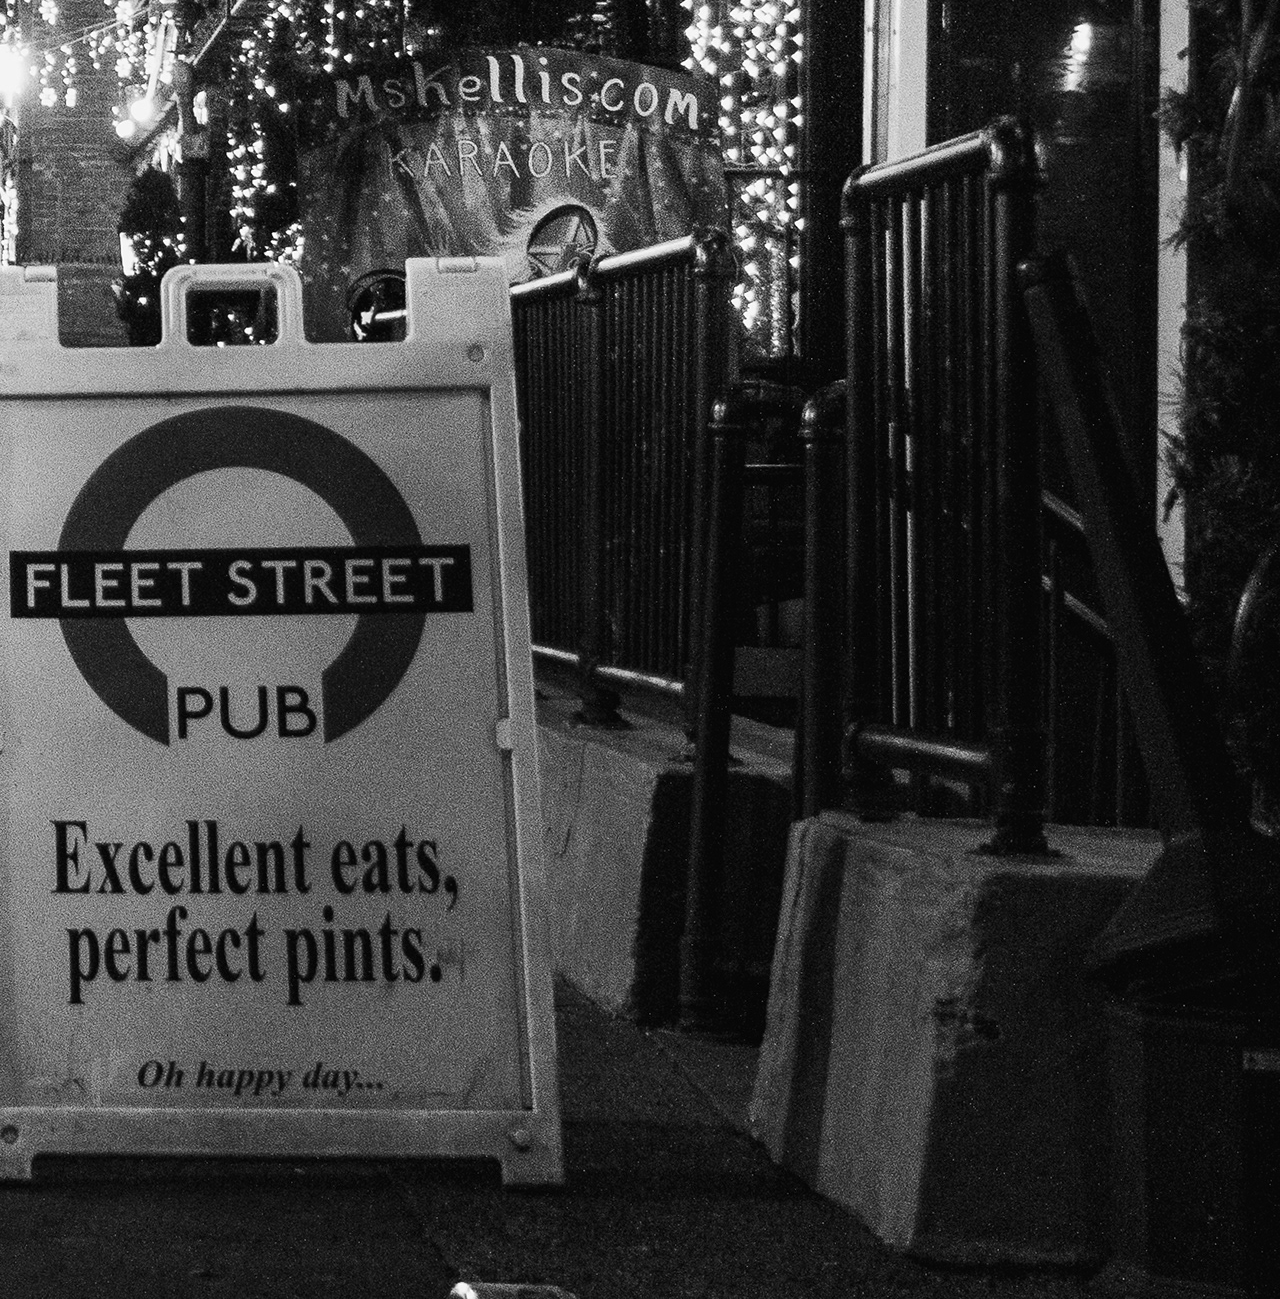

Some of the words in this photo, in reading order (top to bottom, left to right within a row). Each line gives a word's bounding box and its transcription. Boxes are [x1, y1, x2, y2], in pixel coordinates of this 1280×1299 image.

[388, 139, 618, 179] KARAOKE
[26, 562, 203, 608] FLEET
[227, 557, 455, 606] STREET
[176, 685, 318, 740] PUB
[49, 819, 311, 895] Excellent
[330, 824, 459, 911] eats,
[66, 905, 266, 1004] perfect
[284, 905, 443, 1005] pints.
[137, 1059, 185, 1089] Oh
[195, 1061, 292, 1096] happy
[301, 1061, 385, 1095] day...
